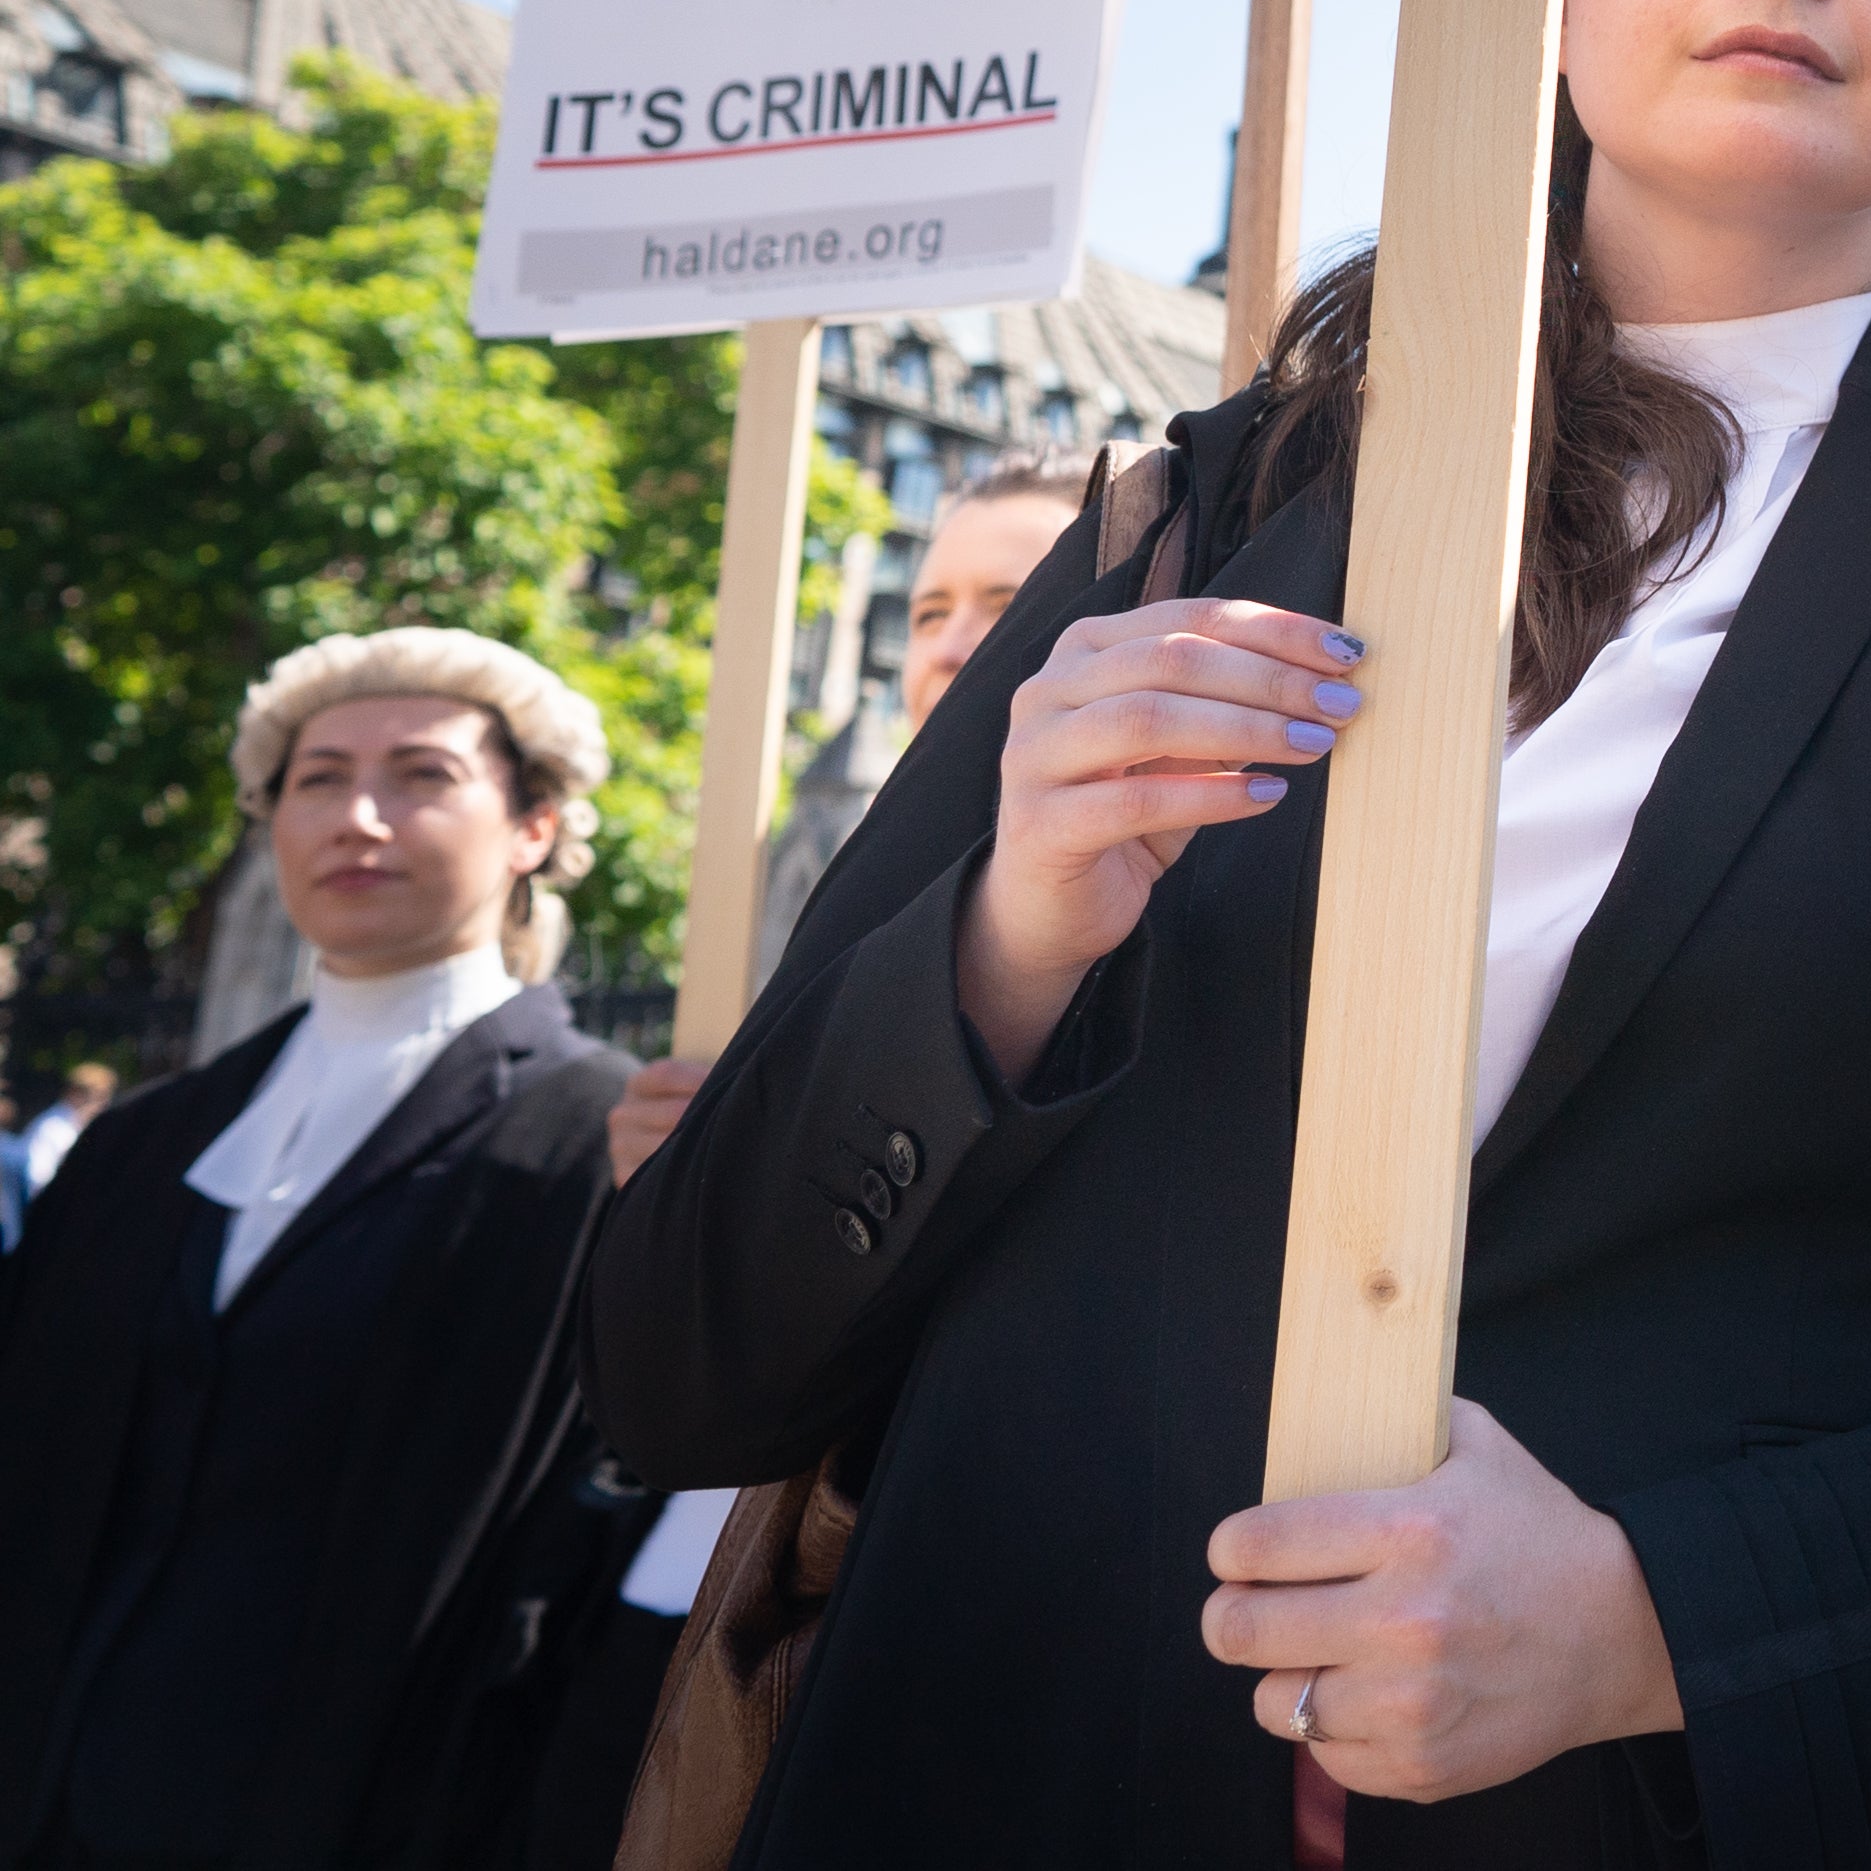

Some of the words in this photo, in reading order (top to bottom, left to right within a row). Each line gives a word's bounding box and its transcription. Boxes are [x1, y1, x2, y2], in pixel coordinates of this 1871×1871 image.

[540, 91, 684, 156] IT’S
[707, 51, 1058, 145] CRIMINAL
[641, 216, 944, 281] haldane.org
